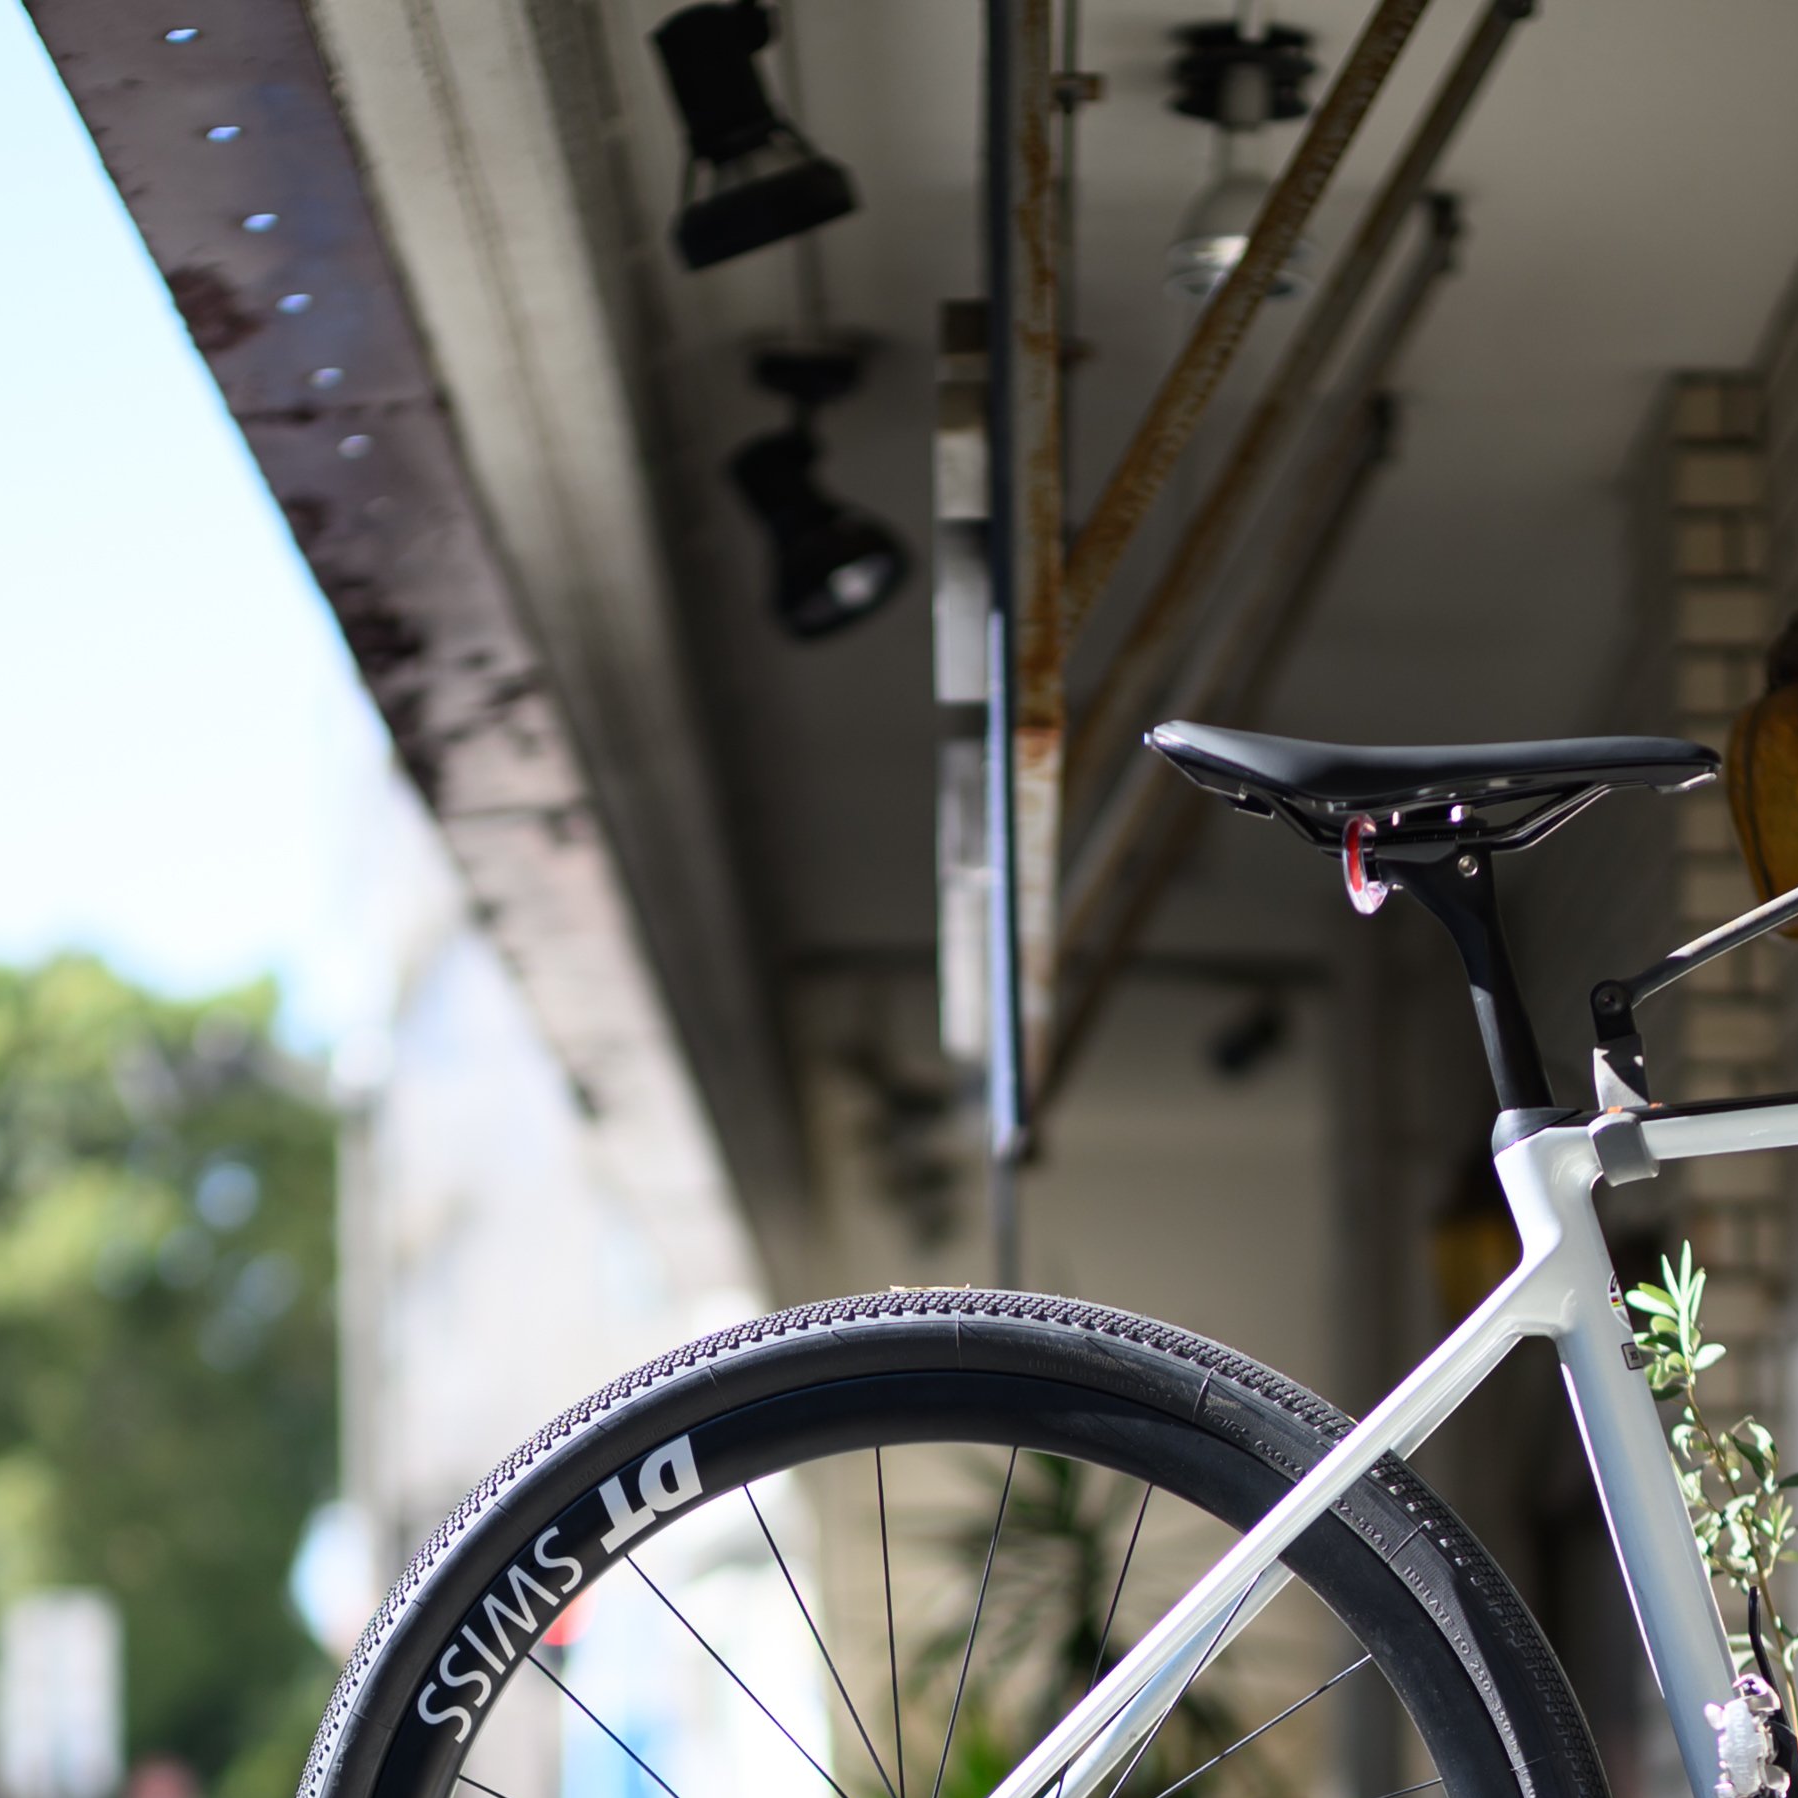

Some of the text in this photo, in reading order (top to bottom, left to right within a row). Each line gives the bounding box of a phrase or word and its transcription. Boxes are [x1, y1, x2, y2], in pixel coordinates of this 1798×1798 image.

[598, 1434, 703, 1554] DT
[417, 1524, 584, 1742] SWISS
[1403, 1566, 1454, 1629] INFLATE
[1453, 1632, 1472, 1655] TO
